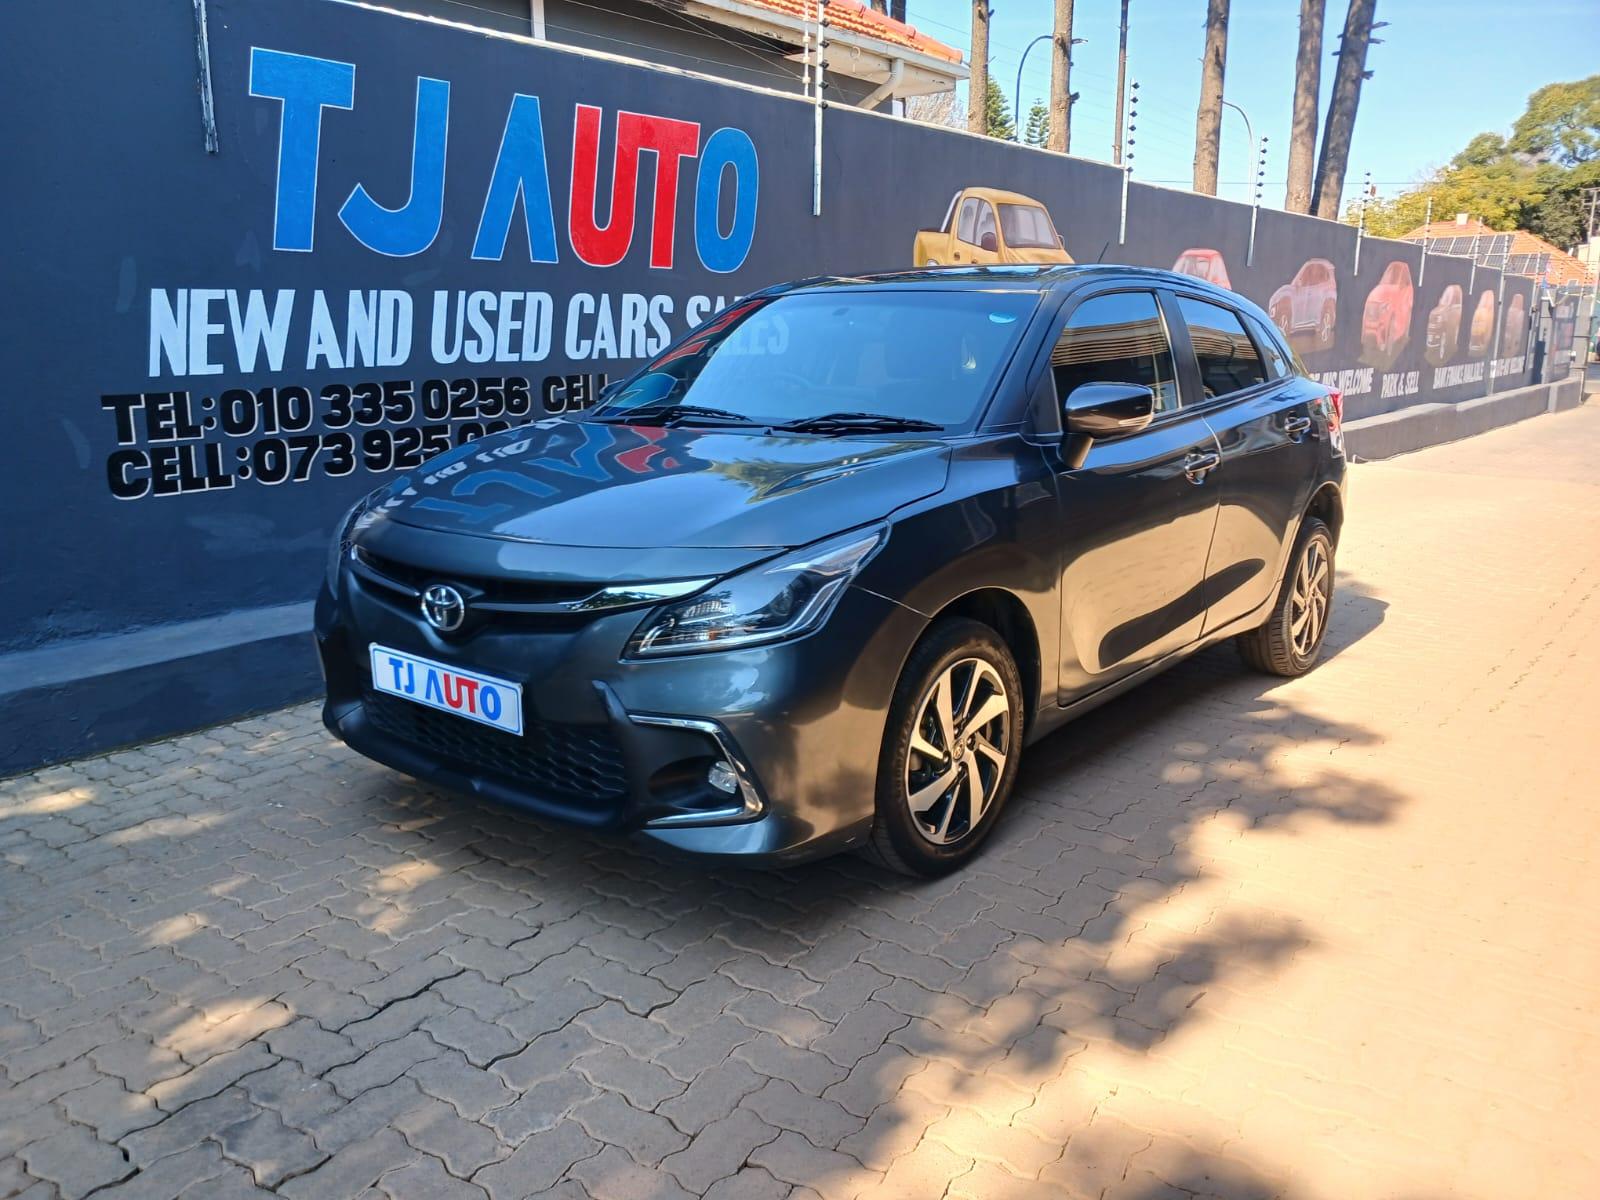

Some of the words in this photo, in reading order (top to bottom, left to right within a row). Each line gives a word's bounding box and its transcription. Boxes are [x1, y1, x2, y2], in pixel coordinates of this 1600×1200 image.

[249, 46, 450, 257] TJ
[471, 93, 759, 273] AUTO
[148, 287, 295, 378] NEW
[306, 288, 412, 371] AND
[431, 290, 551, 365] USED
[565, 294, 673, 360] CARS
[320, 380, 415, 429] 335
[421, 376, 531, 421] 0256
[363, 424, 451, 473] 925
[389, 657, 415, 694] TJ
[425, 669, 501, 721] AUTO
